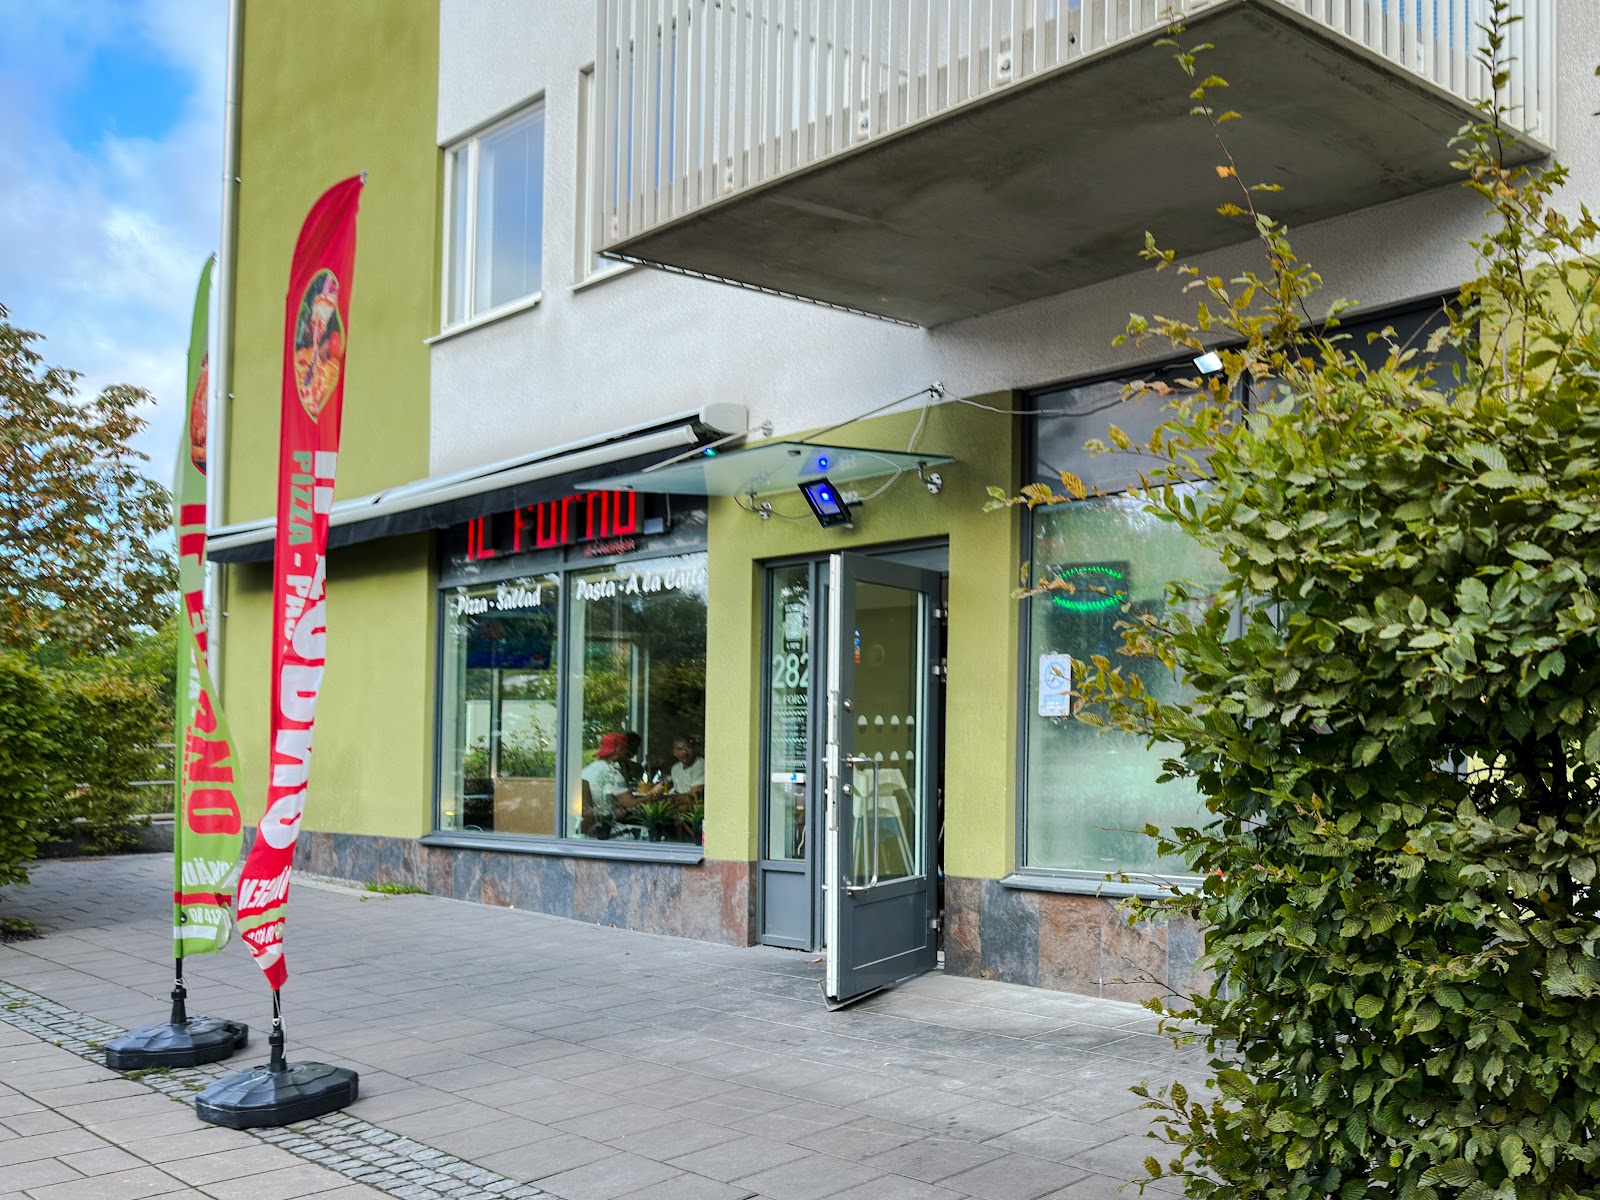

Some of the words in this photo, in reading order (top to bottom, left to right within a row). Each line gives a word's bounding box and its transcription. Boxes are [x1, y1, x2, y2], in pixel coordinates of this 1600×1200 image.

[288, 449, 314, 546] PIZZA
[456, 594, 488, 616] Pizza
[495, 583, 542, 612] Sallad
[575, 576, 616, 601] Pasta
[625, 573, 639, 595] A
[771, 653, 809, 689] 282
